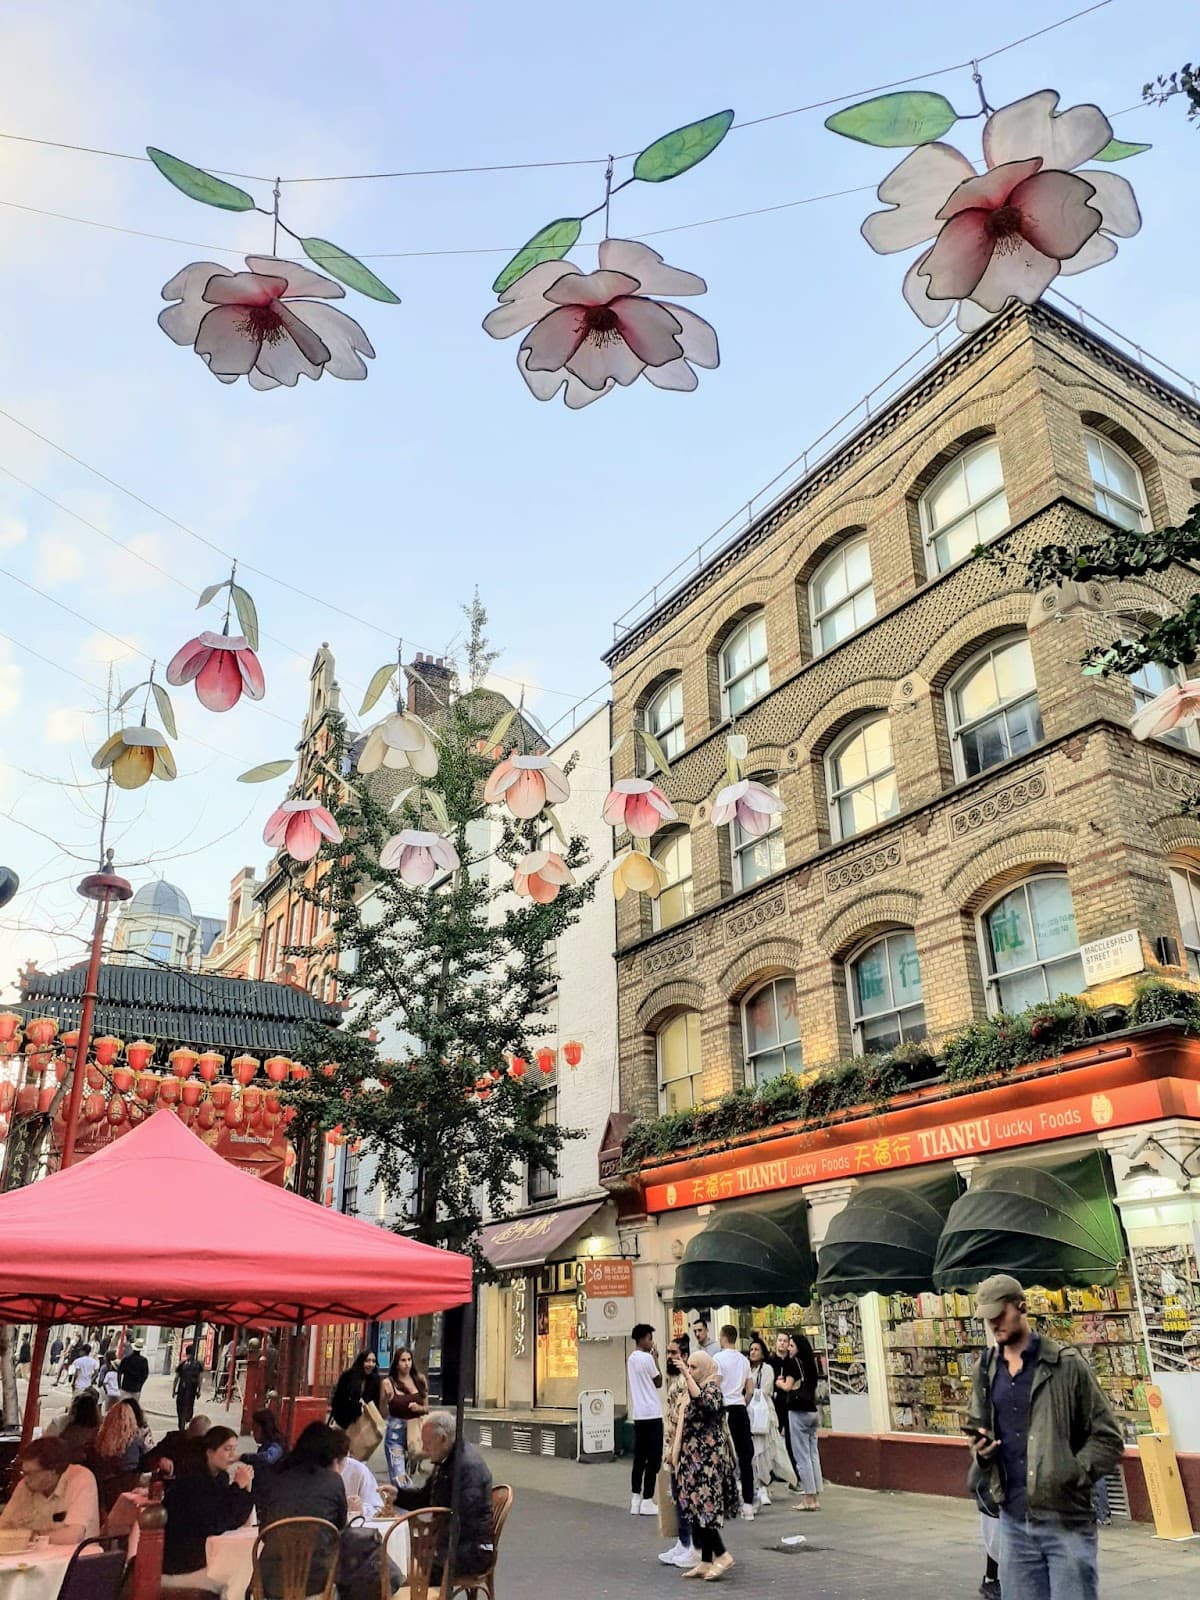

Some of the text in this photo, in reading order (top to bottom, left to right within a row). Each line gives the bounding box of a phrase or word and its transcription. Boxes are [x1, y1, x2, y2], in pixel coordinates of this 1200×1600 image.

[1085, 934, 1133, 955] MACCLESFIELD
[1086, 950, 1110, 964] STREET
[692, 1109, 1082, 1200] 天福行 TIANFU Lucky Foods 天福行 TIANFU Lucky Foods
